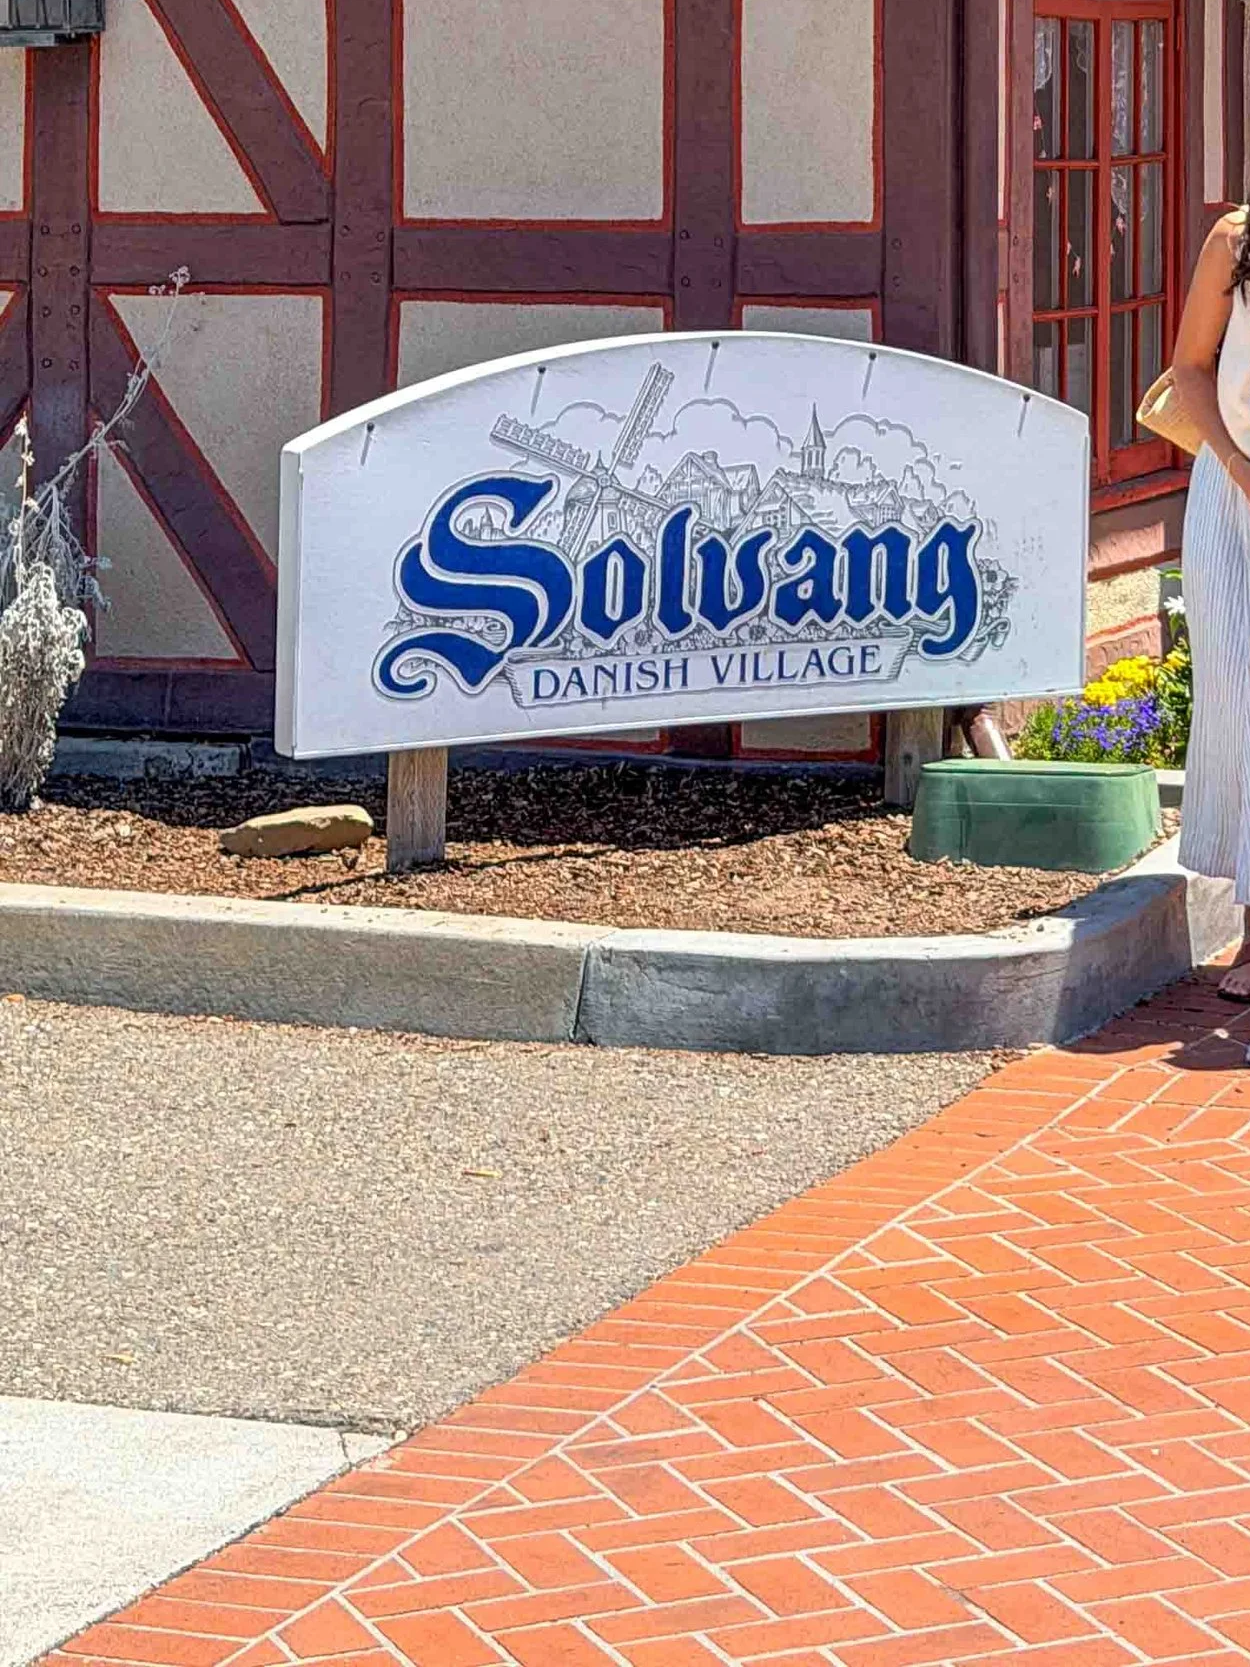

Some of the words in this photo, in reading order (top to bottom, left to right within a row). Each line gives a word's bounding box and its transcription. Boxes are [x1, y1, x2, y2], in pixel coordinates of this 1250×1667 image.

[377, 474, 982, 697] Solvang
[533, 657, 689, 699] DANISH
[710, 644, 882, 684] VILLAGE
